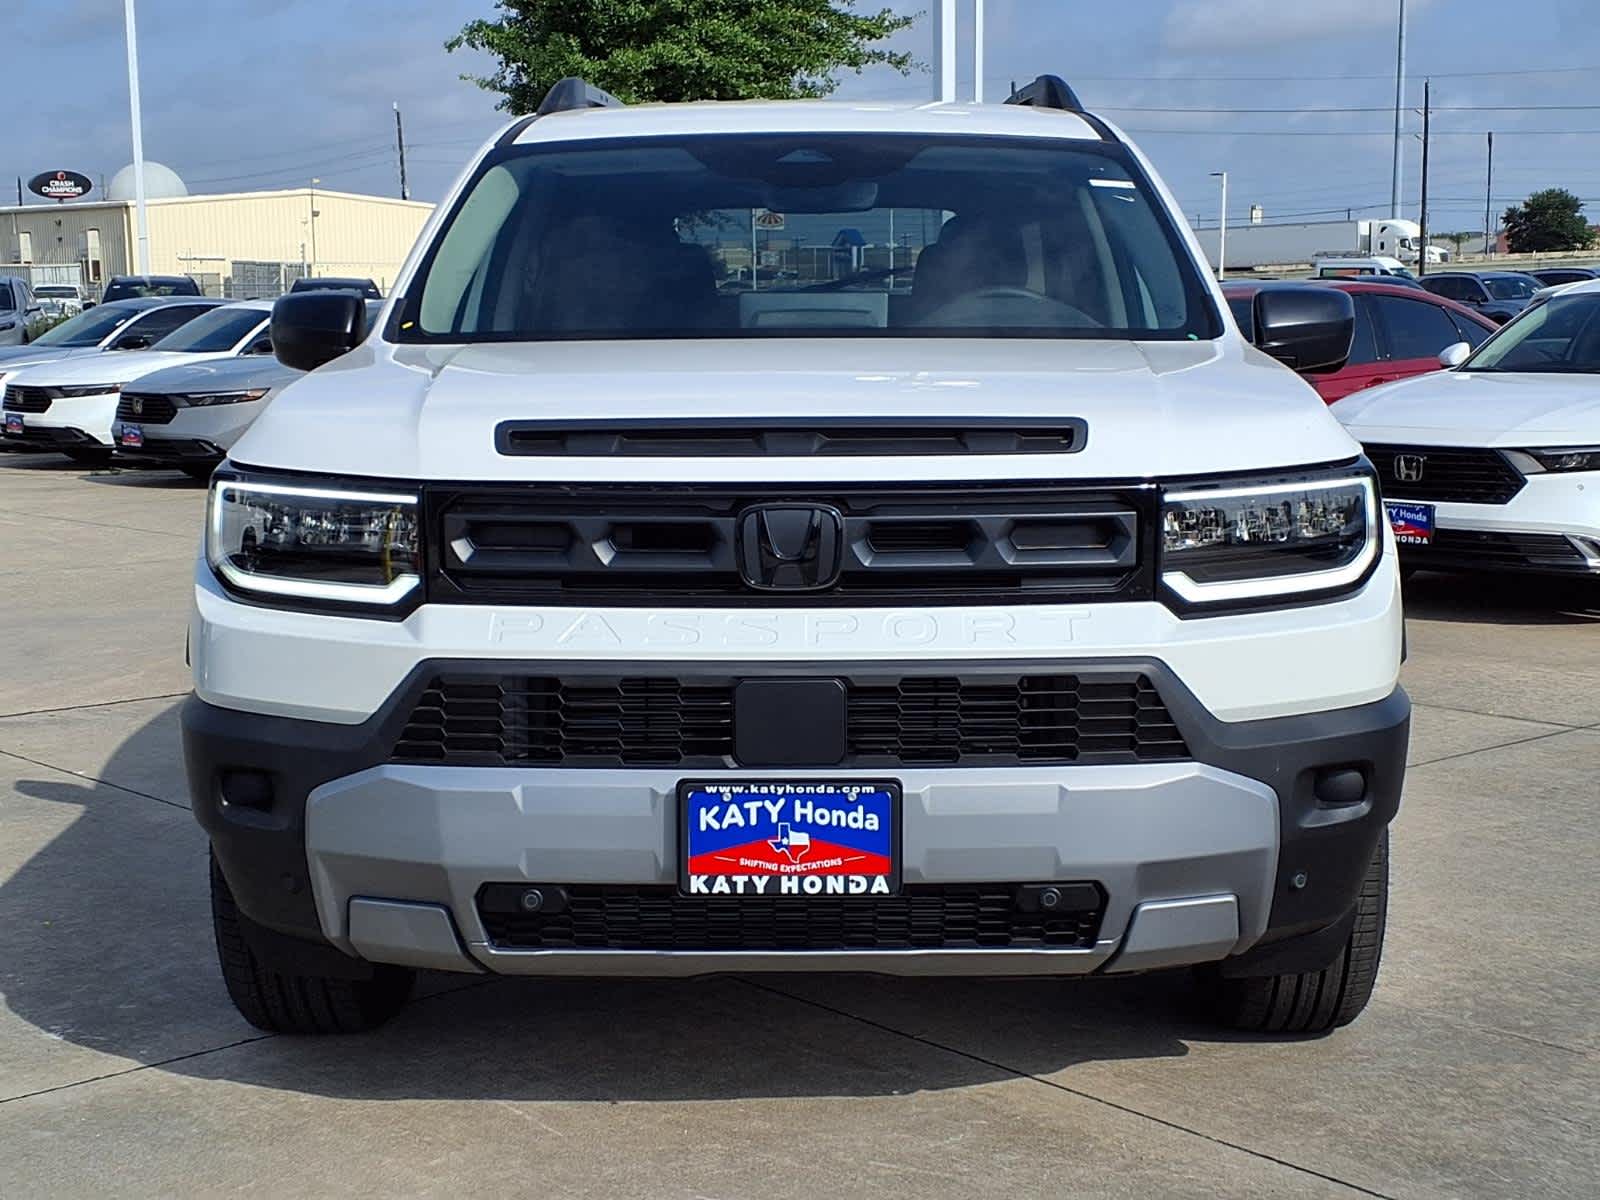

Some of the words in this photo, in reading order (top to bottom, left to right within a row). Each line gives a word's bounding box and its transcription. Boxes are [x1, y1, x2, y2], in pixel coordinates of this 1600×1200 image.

[1400, 508, 1427, 522] Honda
[488, 605, 1092, 645] PASSPORT
[705, 784, 875, 794] www.katyhonda.com
[699, 798, 786, 832] KATY
[794, 799, 880, 831] Honda
[739, 857, 778, 871] SHIFTING
[780, 857, 843, 873] EXPECTATIONS
[689, 875, 770, 895] KATY
[780, 875, 890, 895] HONDA
